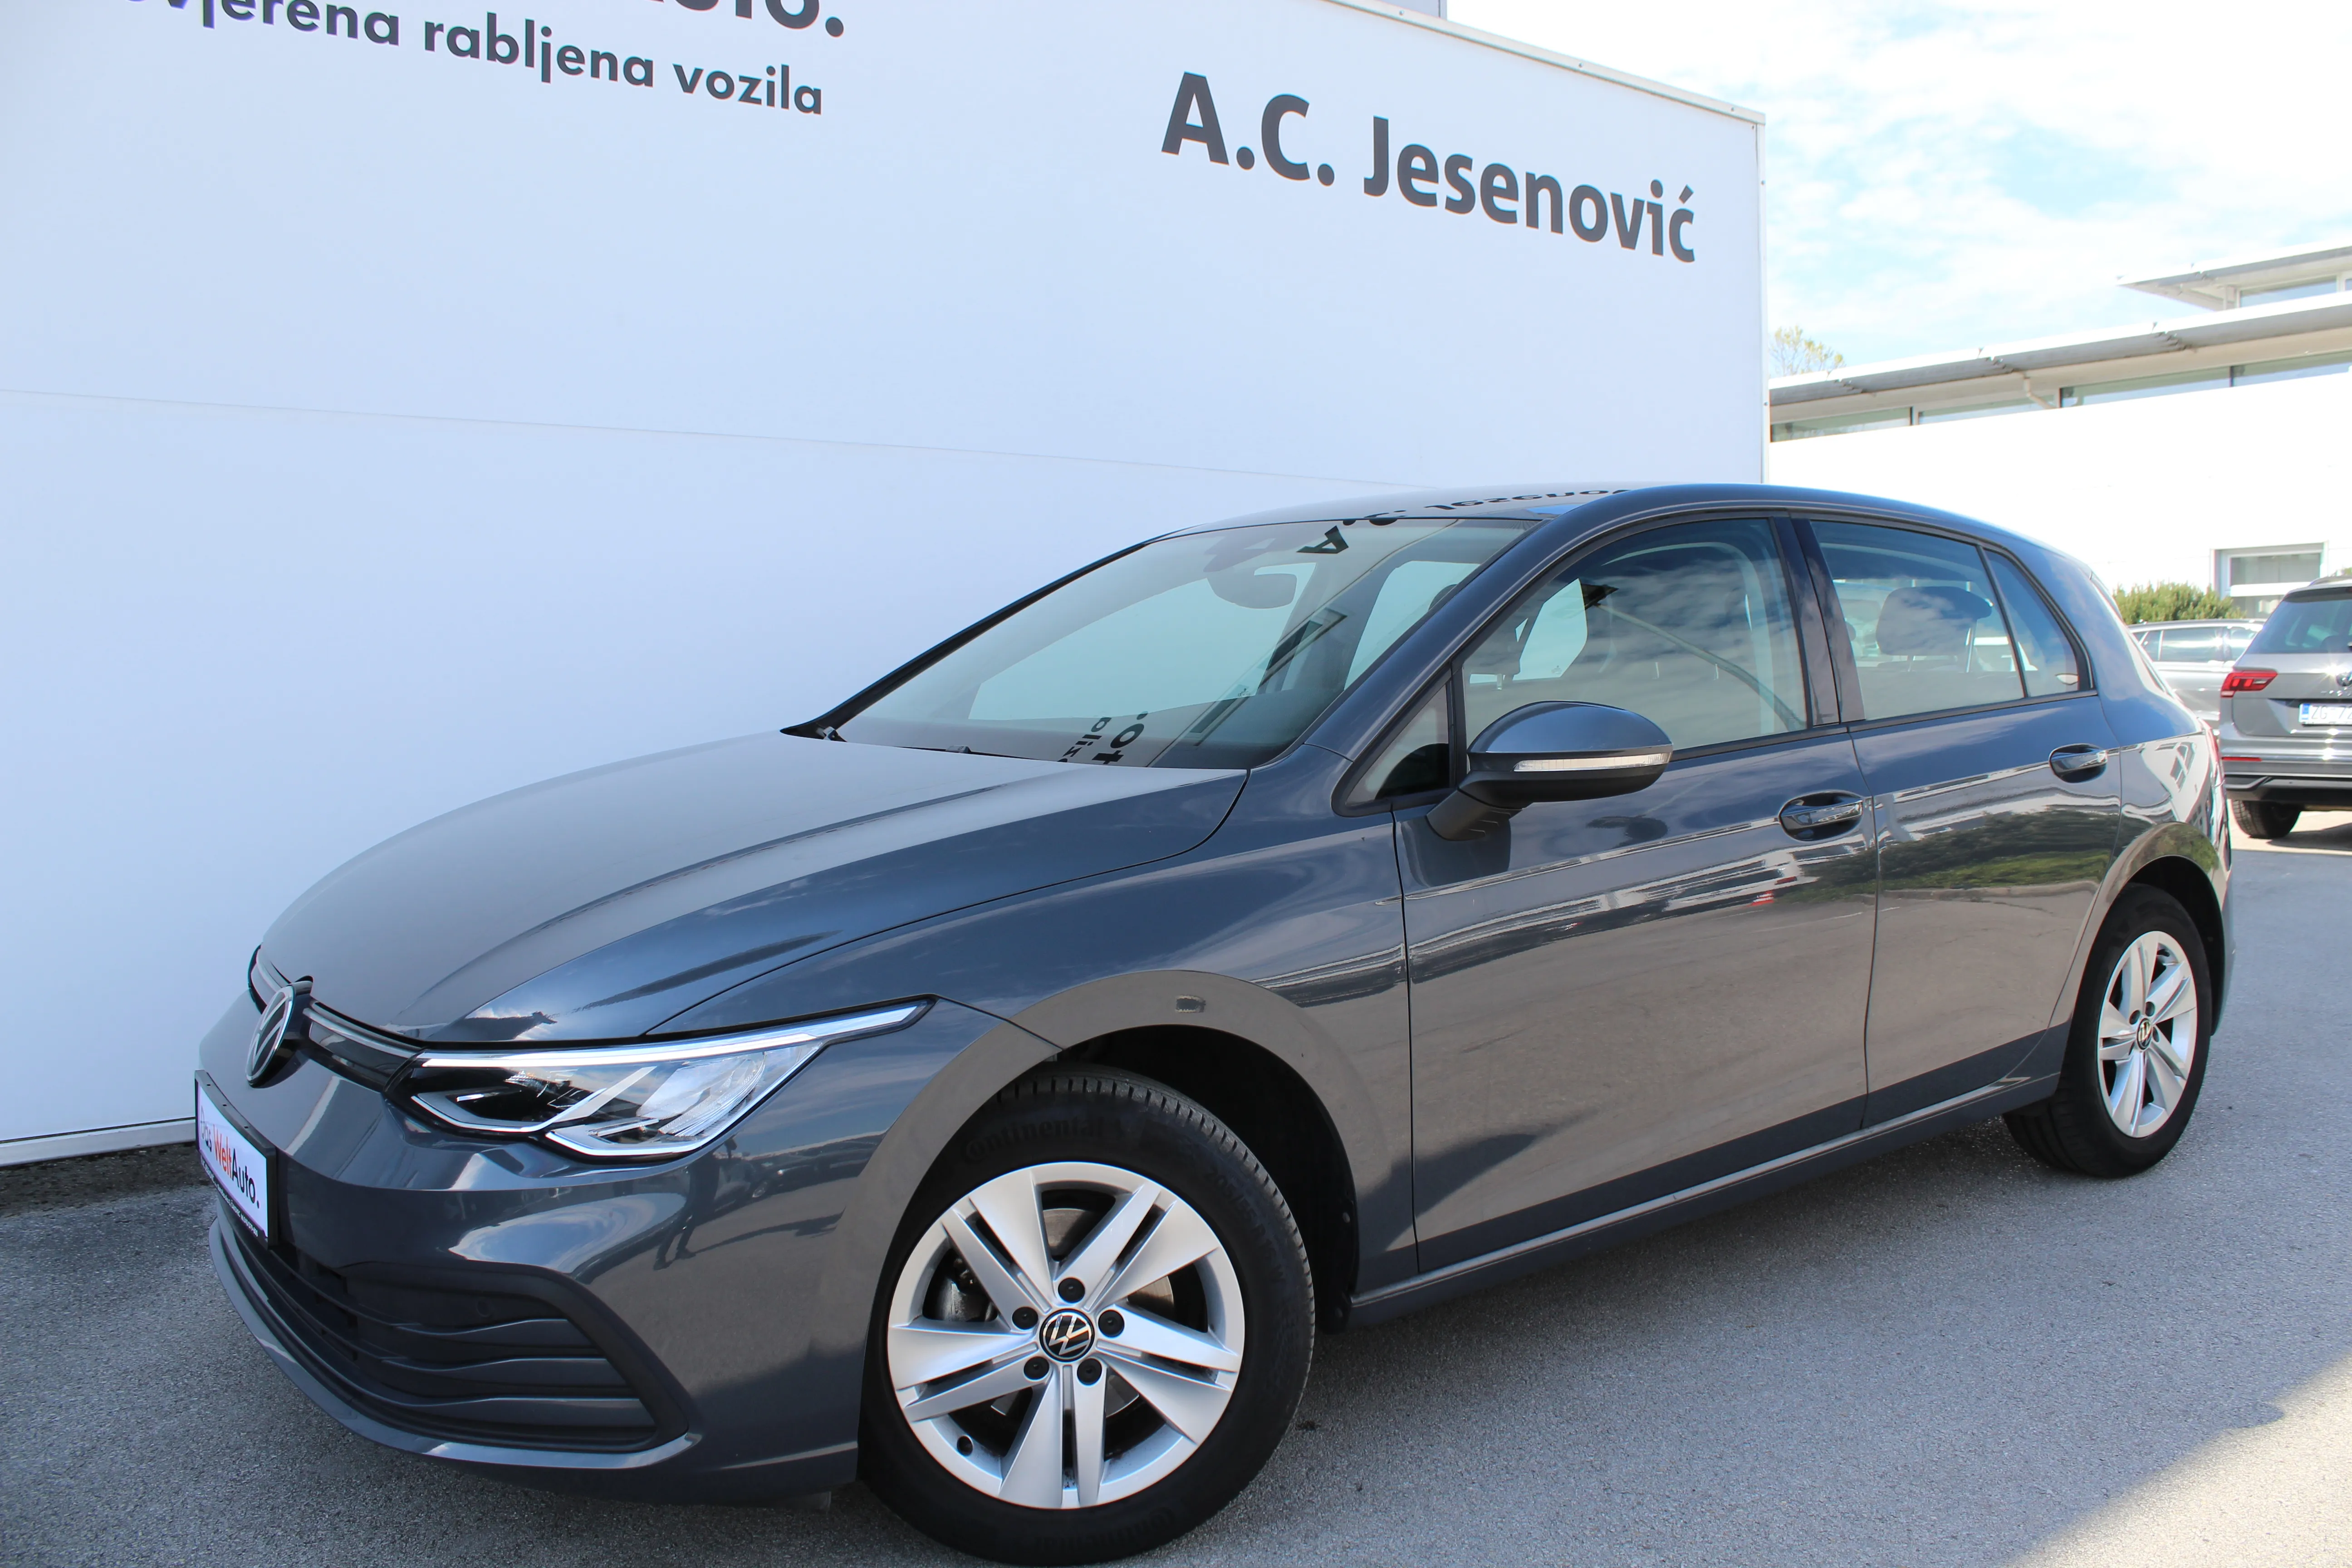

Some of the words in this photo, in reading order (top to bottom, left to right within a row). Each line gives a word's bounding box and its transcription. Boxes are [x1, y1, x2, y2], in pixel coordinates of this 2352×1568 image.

[425, 12, 653, 83] rabljena
[673, 64, 821, 115] vozila
[1161, 71, 1335, 186] A.C.
[1364, 116, 1695, 263] Jesenović
[2311, 705, 2328, 720] ZG
[200, 1105, 212, 1152] Das
[213, 1123, 260, 1209] WeltAuto.
